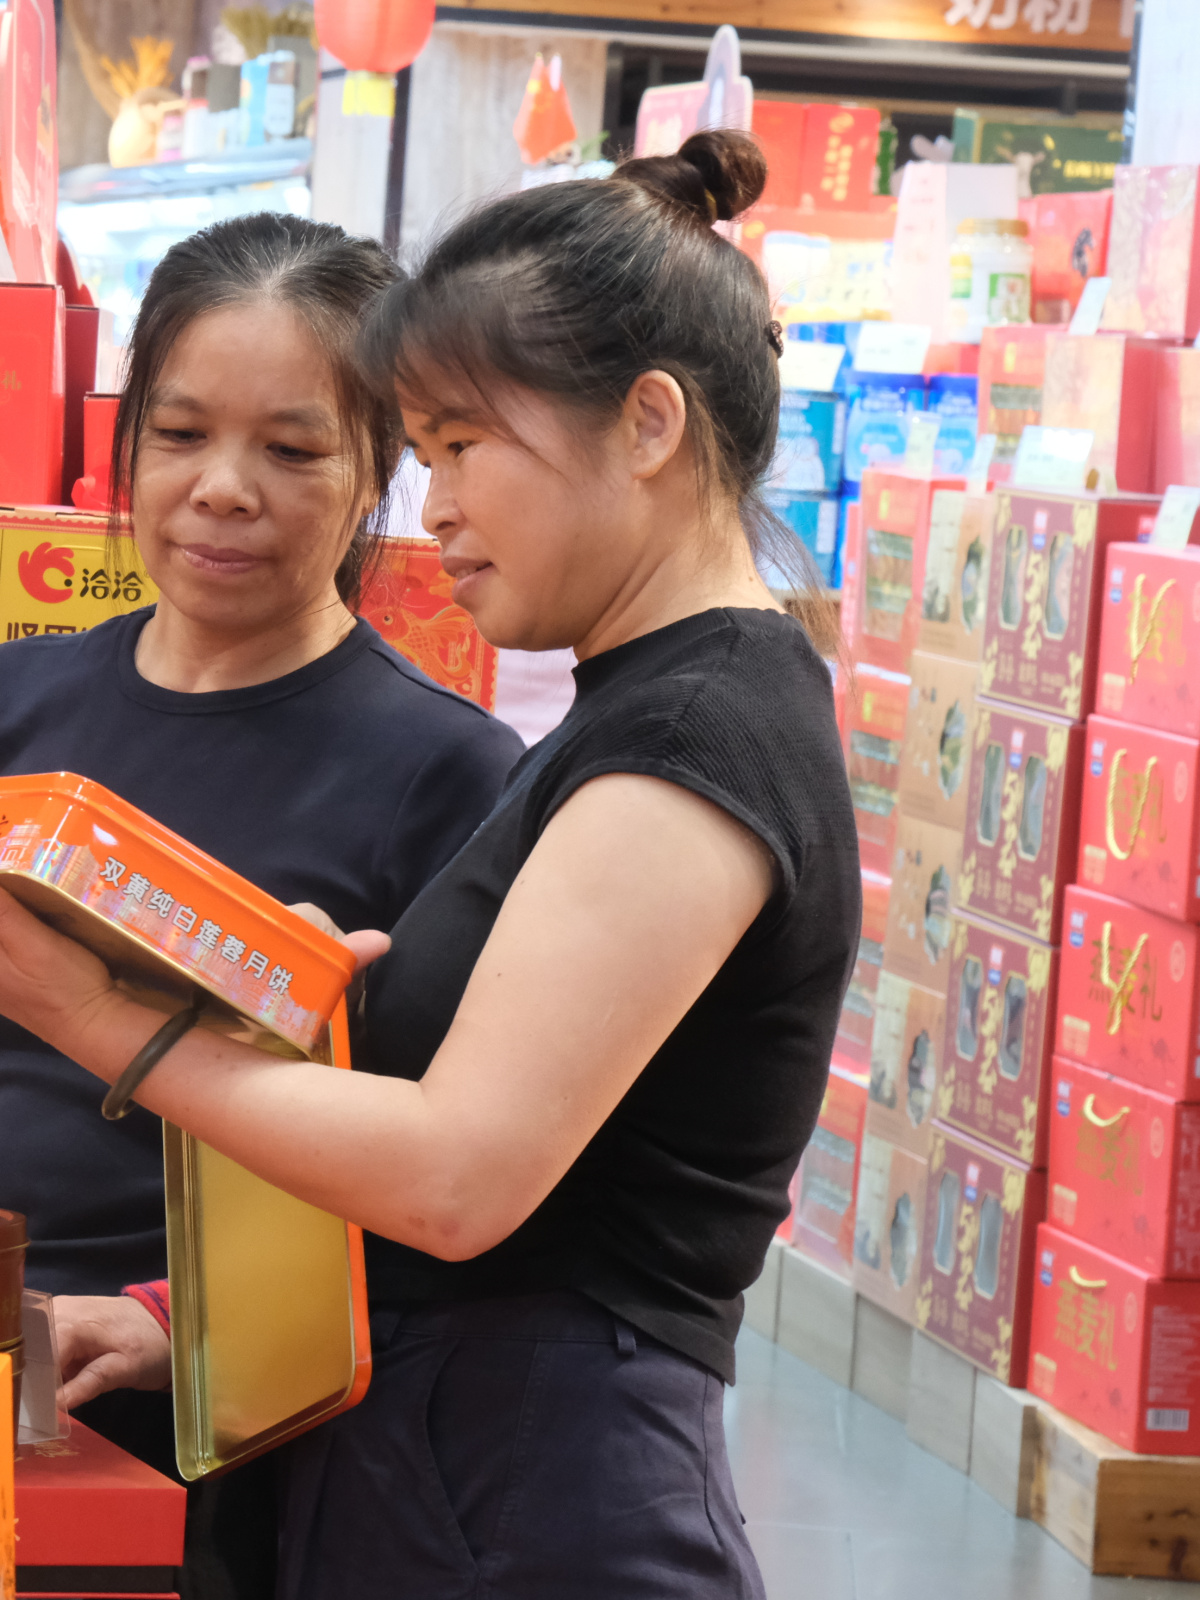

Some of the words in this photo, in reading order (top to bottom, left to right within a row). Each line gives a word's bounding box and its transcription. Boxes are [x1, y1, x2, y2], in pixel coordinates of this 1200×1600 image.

[79, 568, 144, 602] 洽洽
[100, 856, 294, 995] 双黄纯白莲蓉月饼
